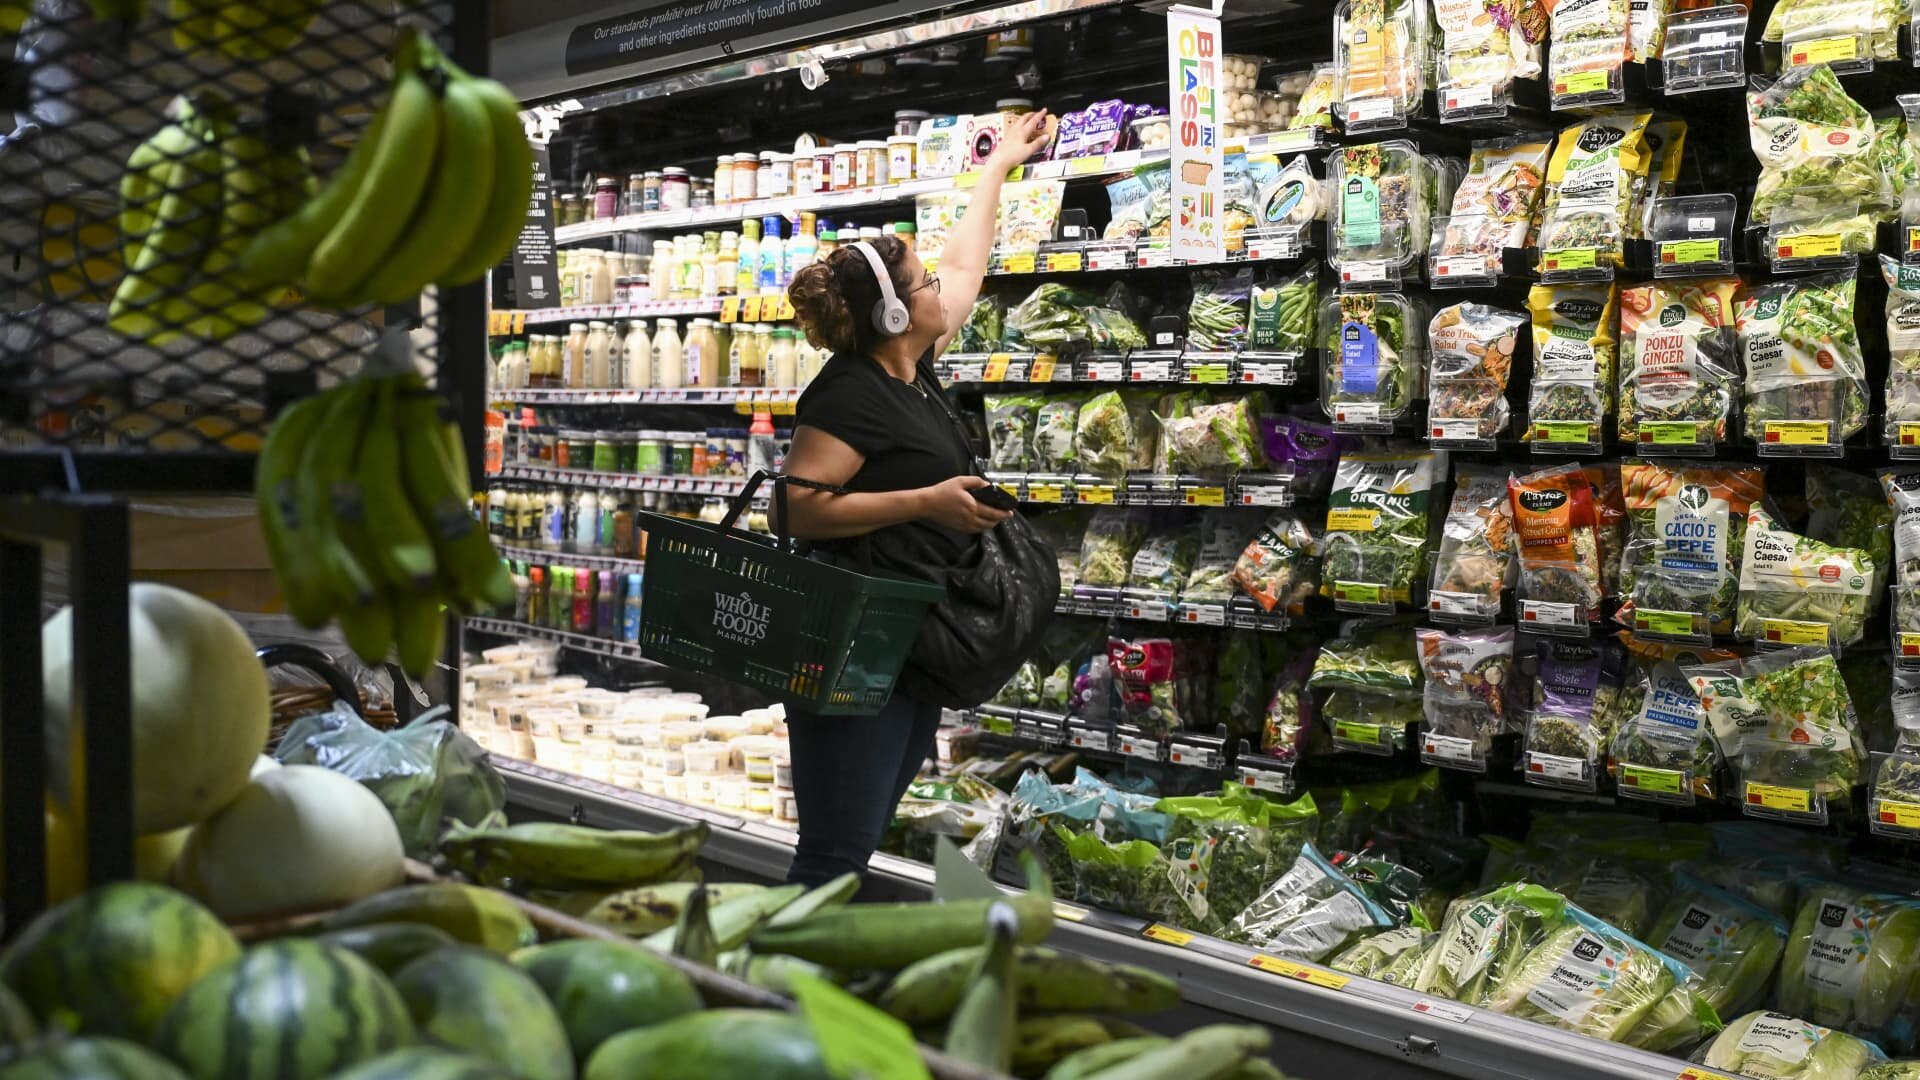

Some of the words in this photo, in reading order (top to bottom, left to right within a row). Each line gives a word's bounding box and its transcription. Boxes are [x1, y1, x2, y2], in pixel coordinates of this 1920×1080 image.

[594, 28, 609, 40] Our
[610, 18, 649, 36] standards
[650, 8, 684, 29] prohibit
[684, 4, 704, 17] over
[619, 40, 634, 53] and
[636, 34, 657, 49] other
[659, 23, 706, 45] ingredients
[708, 9, 755, 31] commonly
[758, 4, 785, 20] found
[787, 1, 797, 13] in
[1197, 31, 1216, 124] BEST
[1179, 29, 1198, 148] CLASS
[1202, 126, 1215, 147] IN
[1584, 131, 1622, 144] Taylor
[1563, 302, 1600, 314] Taylor
[1758, 300, 1778, 313] 365
[1434, 340, 1456, 350] Salad
[1646, 335, 1684, 352] PONZU
[1750, 336, 1782, 352] Classic
[1642, 350, 1684, 366] GINGER
[1750, 350, 1784, 362] Caesar
[1524, 491, 1564, 502] Taylor
[1665, 522, 1704, 538] CACIO
[1708, 524, 1717, 538] E
[1665, 540, 1715, 553] PEPE
[714, 592, 772, 623] WHOLE
[712, 609, 767, 640] FOODS
[716, 630, 757, 646] MARKET
[1554, 673, 1580, 684] Style
[1654, 690, 1701, 709] PEPE
[1648, 712, 1674, 722] PREMIUM
[1675, 718, 1695, 727] SALAD
[1824, 908, 1844, 920] 365
[1578, 942, 1598, 957] 365
[1669, 936, 1693, 950] Hearts
[1694, 946, 1704, 954] of
[1813, 939, 1840, 953] Hearts
[1842, 947, 1852, 956] of
[1811, 948, 1846, 964] Romaine
[1556, 965, 1583, 982] Hearts
[1550, 972, 1582, 992] Romaine
[1752, 1028, 1791, 1040] Romaine
[1755, 1022, 1786, 1032] Hearts
